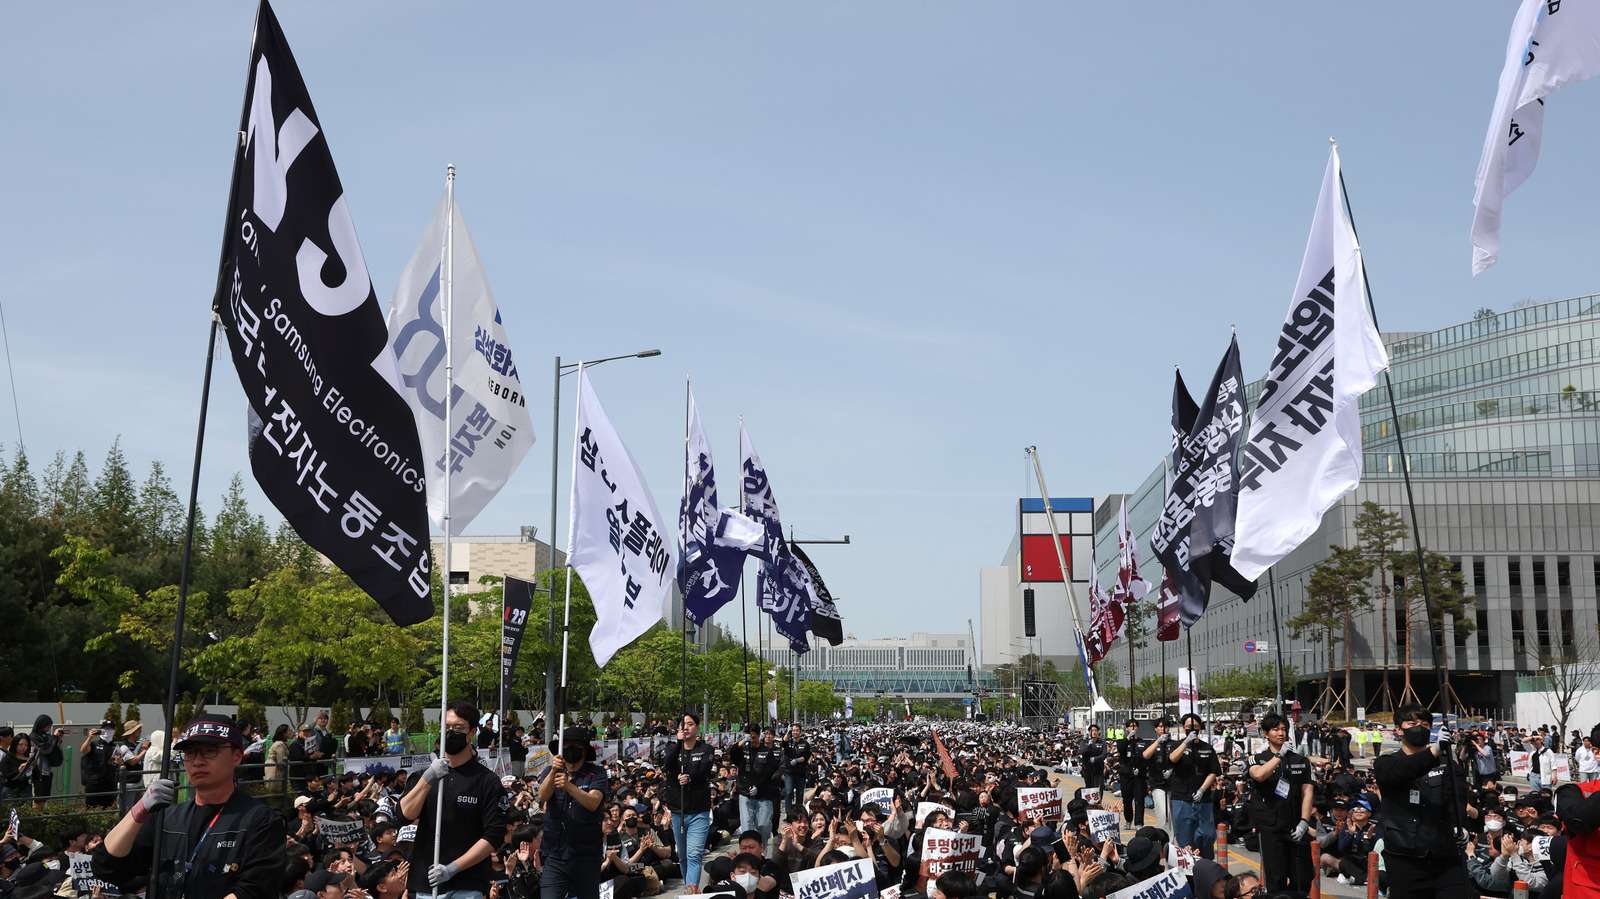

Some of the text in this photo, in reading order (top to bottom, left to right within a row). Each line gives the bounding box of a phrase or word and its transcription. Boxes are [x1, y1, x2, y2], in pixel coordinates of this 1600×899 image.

[264, 298, 426, 493] Samsung Electronics
[927, 837, 976, 854] 투명하게
